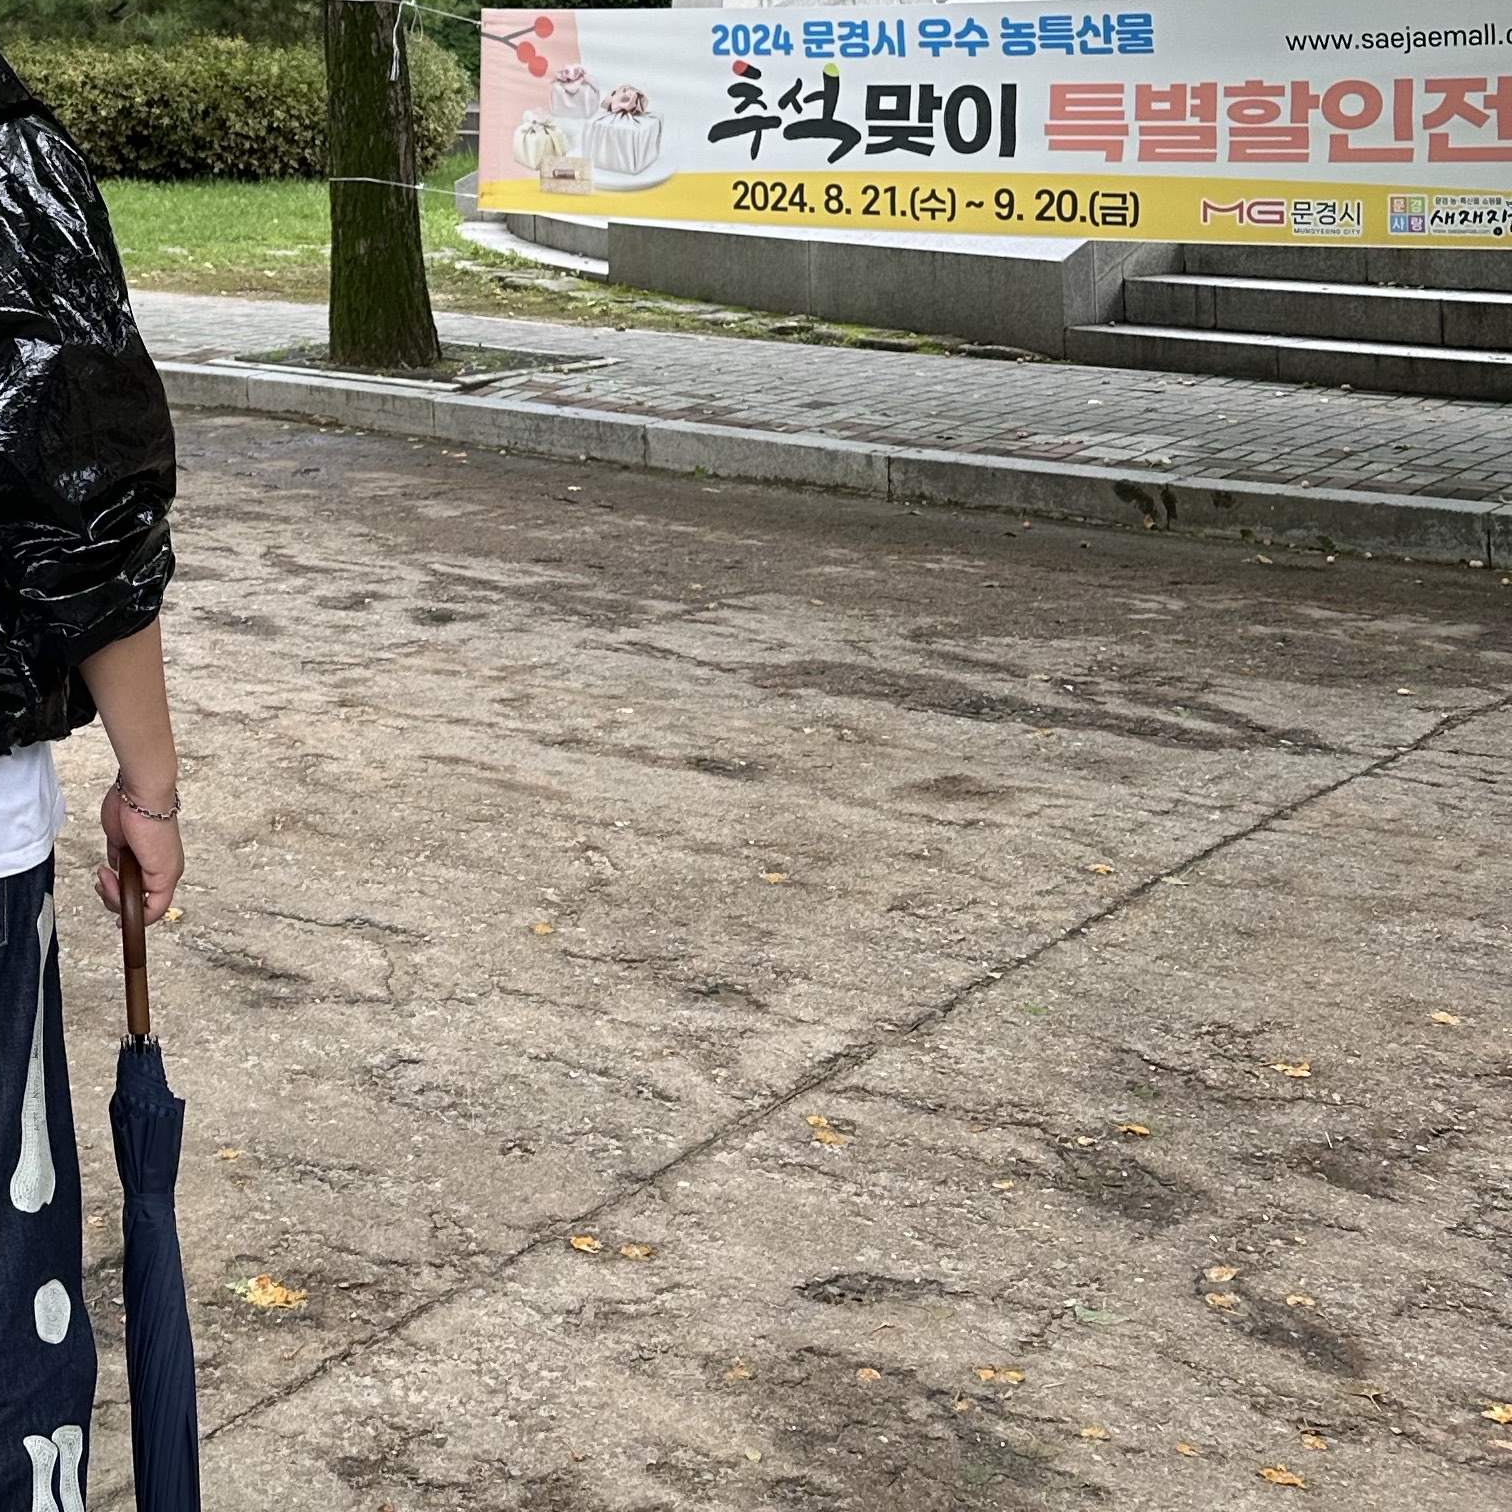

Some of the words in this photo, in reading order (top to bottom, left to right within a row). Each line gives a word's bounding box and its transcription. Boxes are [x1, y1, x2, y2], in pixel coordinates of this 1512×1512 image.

[711, 23, 794, 57] 2024
[803, 18, 907, 59] 문경시
[918, 17, 990, 58] 우수
[1000, 13, 1155, 57] 농특산물
[1044, 75, 1512, 163] 특별할인전
[732, 180, 816, 214] 2024.
[823, 183, 852, 216] 8.
[861, 184, 957, 223] 21.(수)
[994, 188, 1024, 222] 9.
[1034, 189, 1140, 228] 20.(금)
[1202, 200, 1285, 224] MG
[1291, 201, 1361, 226] 문경시
